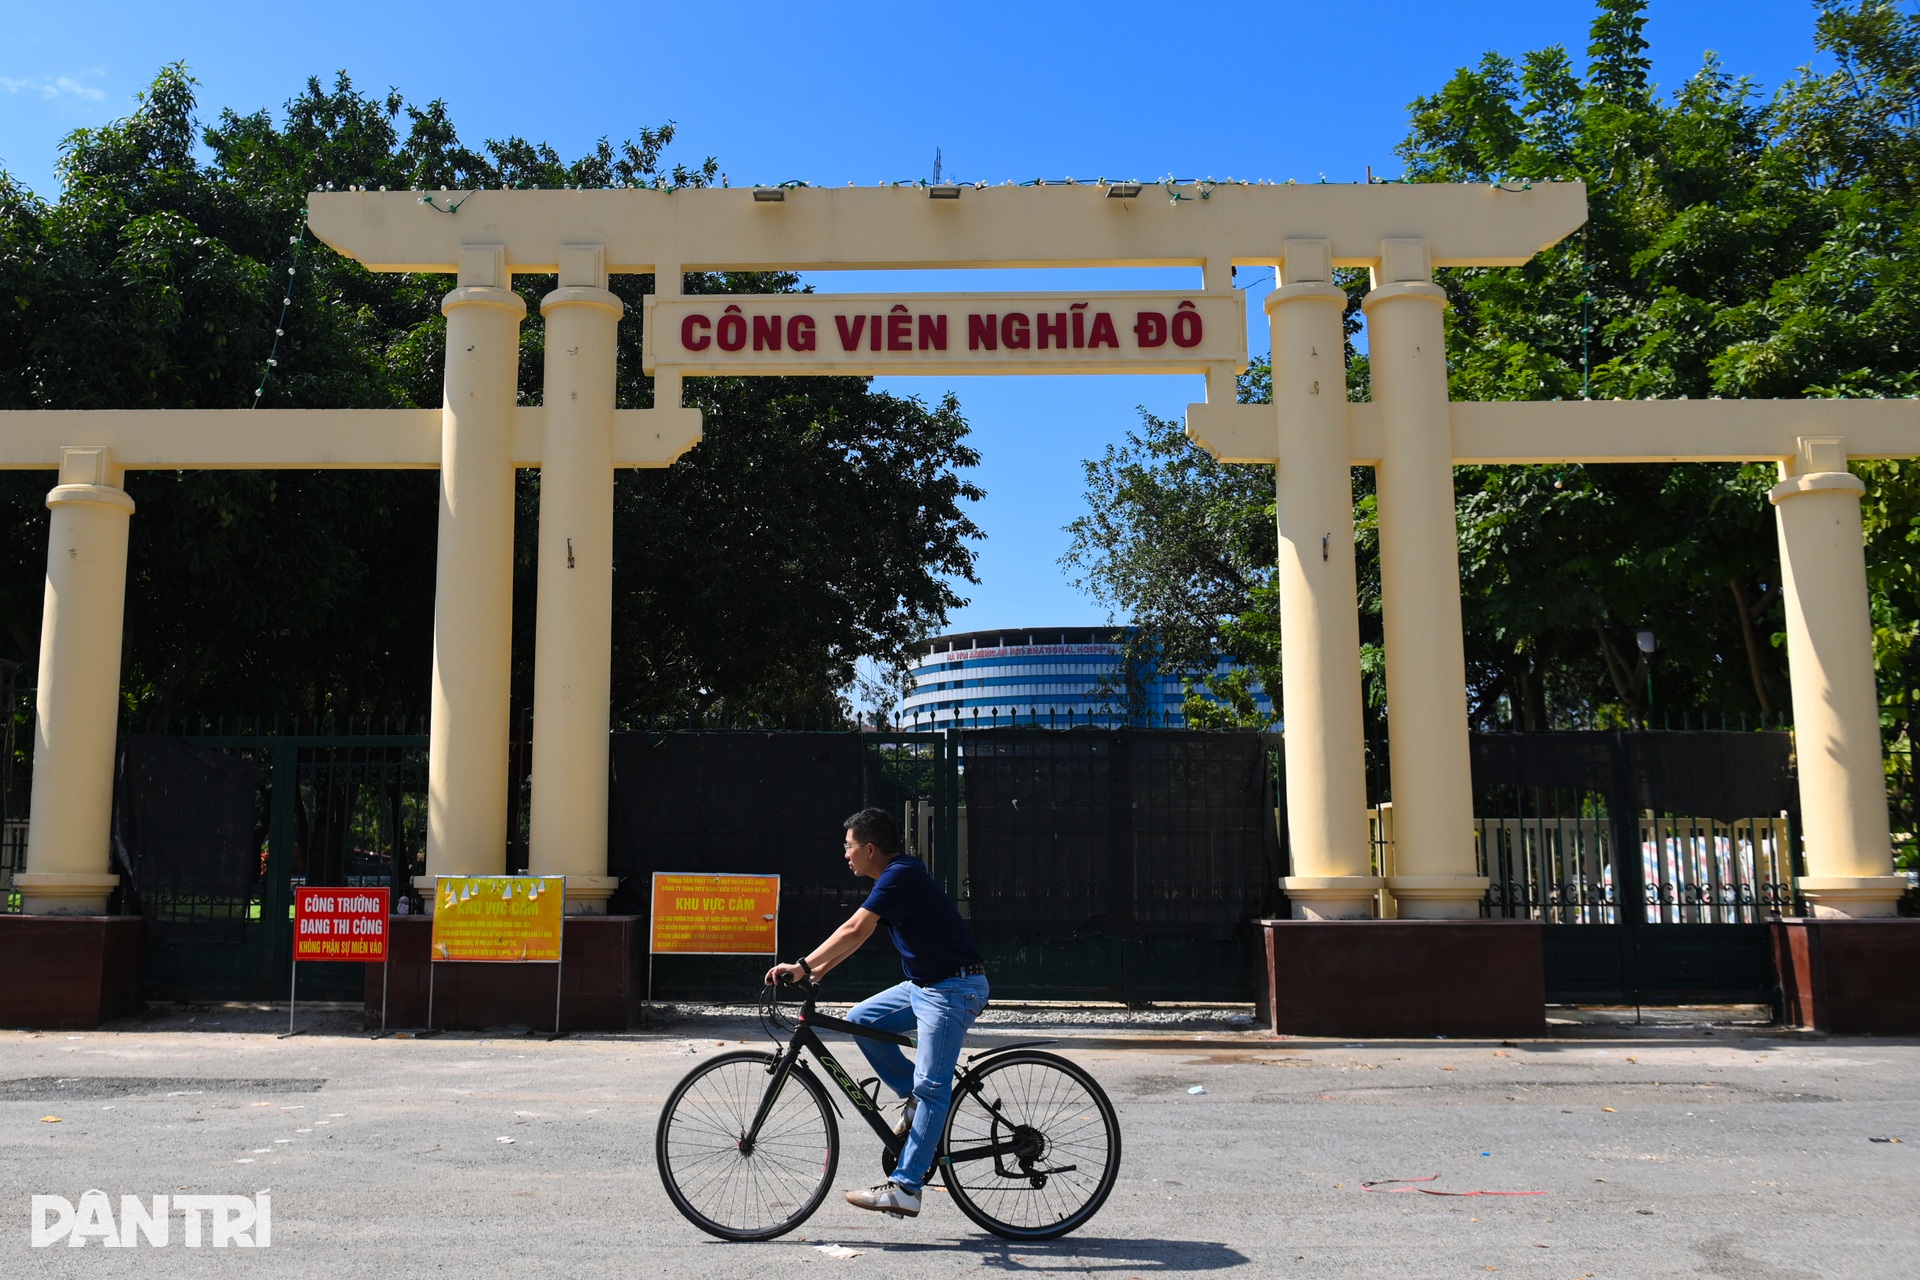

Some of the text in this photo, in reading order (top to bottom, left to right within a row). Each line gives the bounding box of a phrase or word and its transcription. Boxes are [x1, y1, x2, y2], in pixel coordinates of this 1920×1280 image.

[681, 300, 1203, 352] CÔNG VIÊN NGHĨA ĐÔ
[305, 894, 380, 913] CÔNG TRƯỜNG
[675, 894, 755, 913] KHU VỰC CẤM
[300, 916, 382, 935] ĐANG THI CÔNG
[299, 938, 320, 953] KHÔNG
[322, 938, 340, 956] PHẬN
[341, 940, 351, 956] SỰ
[370, 938, 382, 954] VÀO
